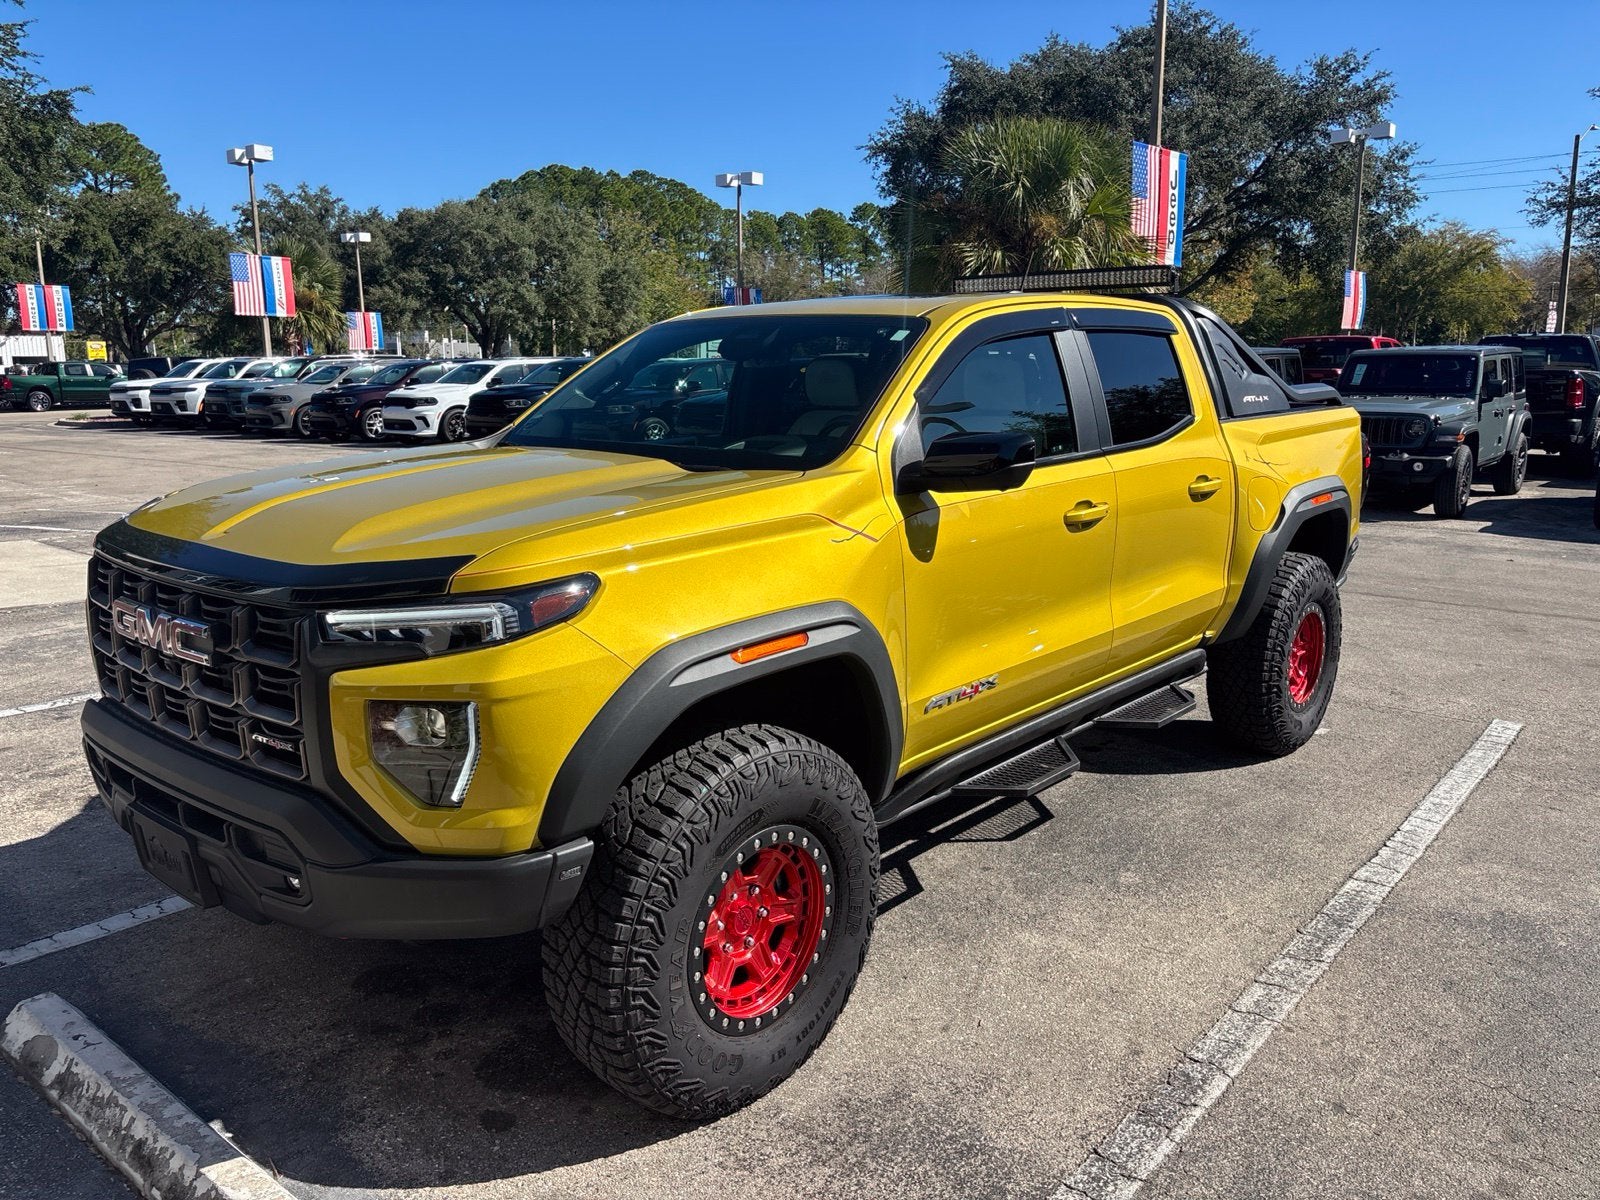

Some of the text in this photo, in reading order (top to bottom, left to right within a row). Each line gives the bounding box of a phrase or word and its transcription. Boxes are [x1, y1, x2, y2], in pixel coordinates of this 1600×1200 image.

[1167, 169, 1178, 250] Jeep
[56, 297, 65, 328] TRUCKS
[1243, 395, 1269, 403] AT4X
[112, 596, 212, 667] GMC
[924, 673, 999, 714] AT4X
[252, 734, 294, 752] AT4X
[806, 797, 864, 937] WRANGLER
[669, 917, 744, 1076] GOODYEAR
